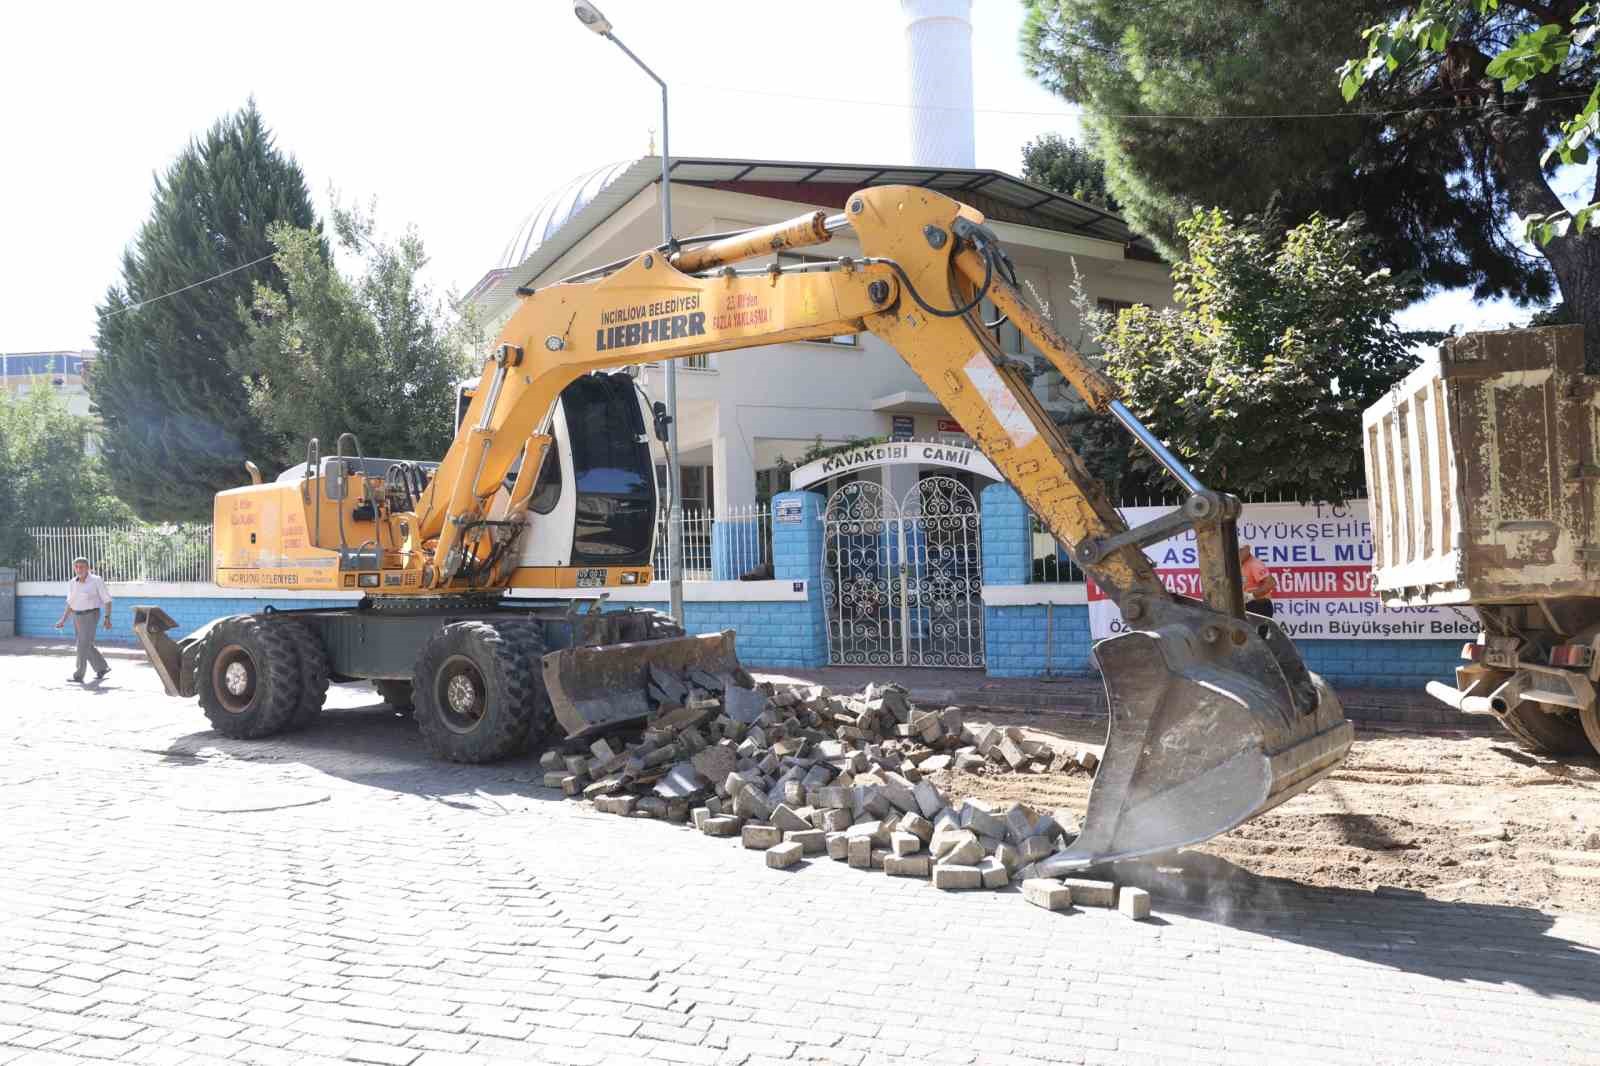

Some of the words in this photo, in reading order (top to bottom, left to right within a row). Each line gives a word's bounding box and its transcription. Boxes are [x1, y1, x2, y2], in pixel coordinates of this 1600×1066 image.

[601, 304, 647, 324] İNCİRLİOVA
[649, 294, 700, 316] BELEDİYESİ
[596, 311, 706, 351] LIEBHERR
[922, 446, 970, 466] CAMİİ
[1237, 520, 1371, 542] ÜYÜKŞEHİR
[1254, 545, 1326, 562] ENEL
[1272, 568, 1337, 593] AĞMUR
[1289, 600, 1320, 616] İÇİN
[1280, 621, 1324, 637] Aydın
[1329, 619, 1425, 637] Büyükşehir
[1430, 620, 1480, 634] Beled
